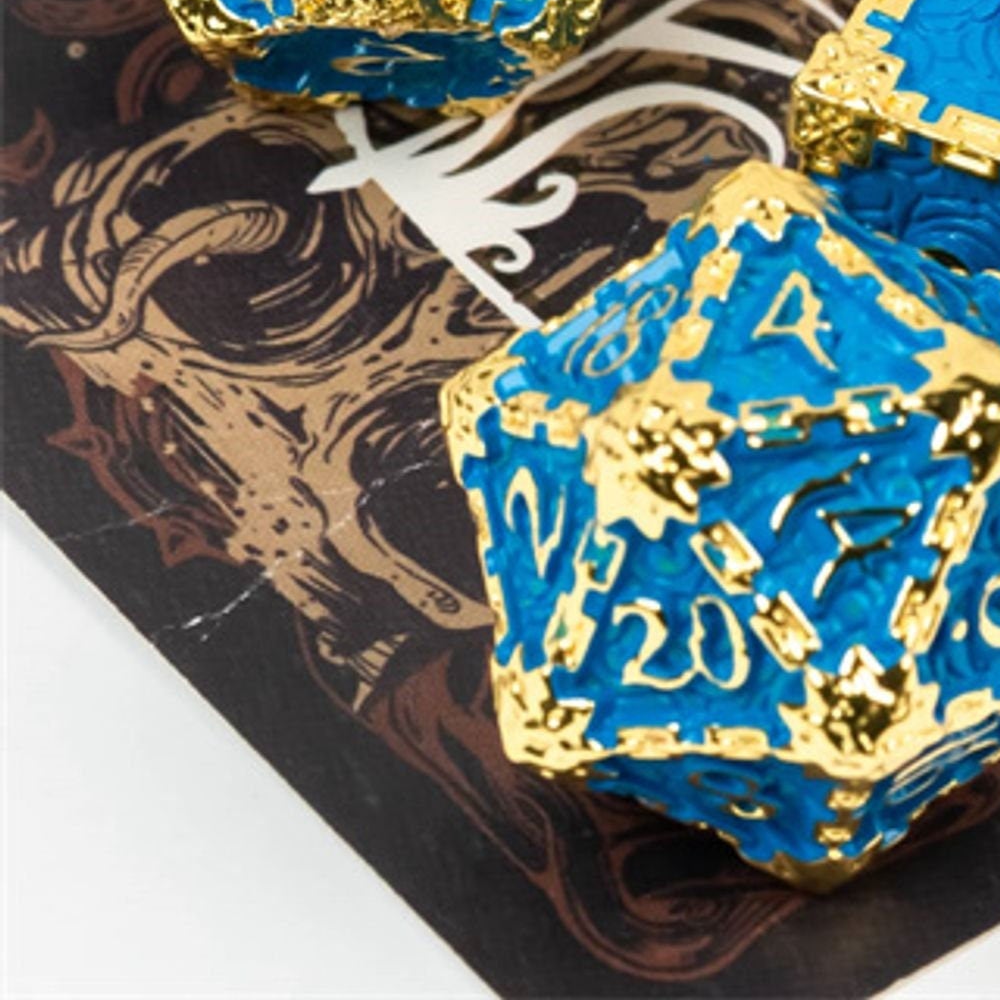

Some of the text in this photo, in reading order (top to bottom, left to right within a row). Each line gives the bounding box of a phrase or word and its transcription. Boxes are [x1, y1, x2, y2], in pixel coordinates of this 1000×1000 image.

[752, 271, 841, 372] 4
[504, 466, 568, 580] 2
[612, 596, 751, 689] 20
